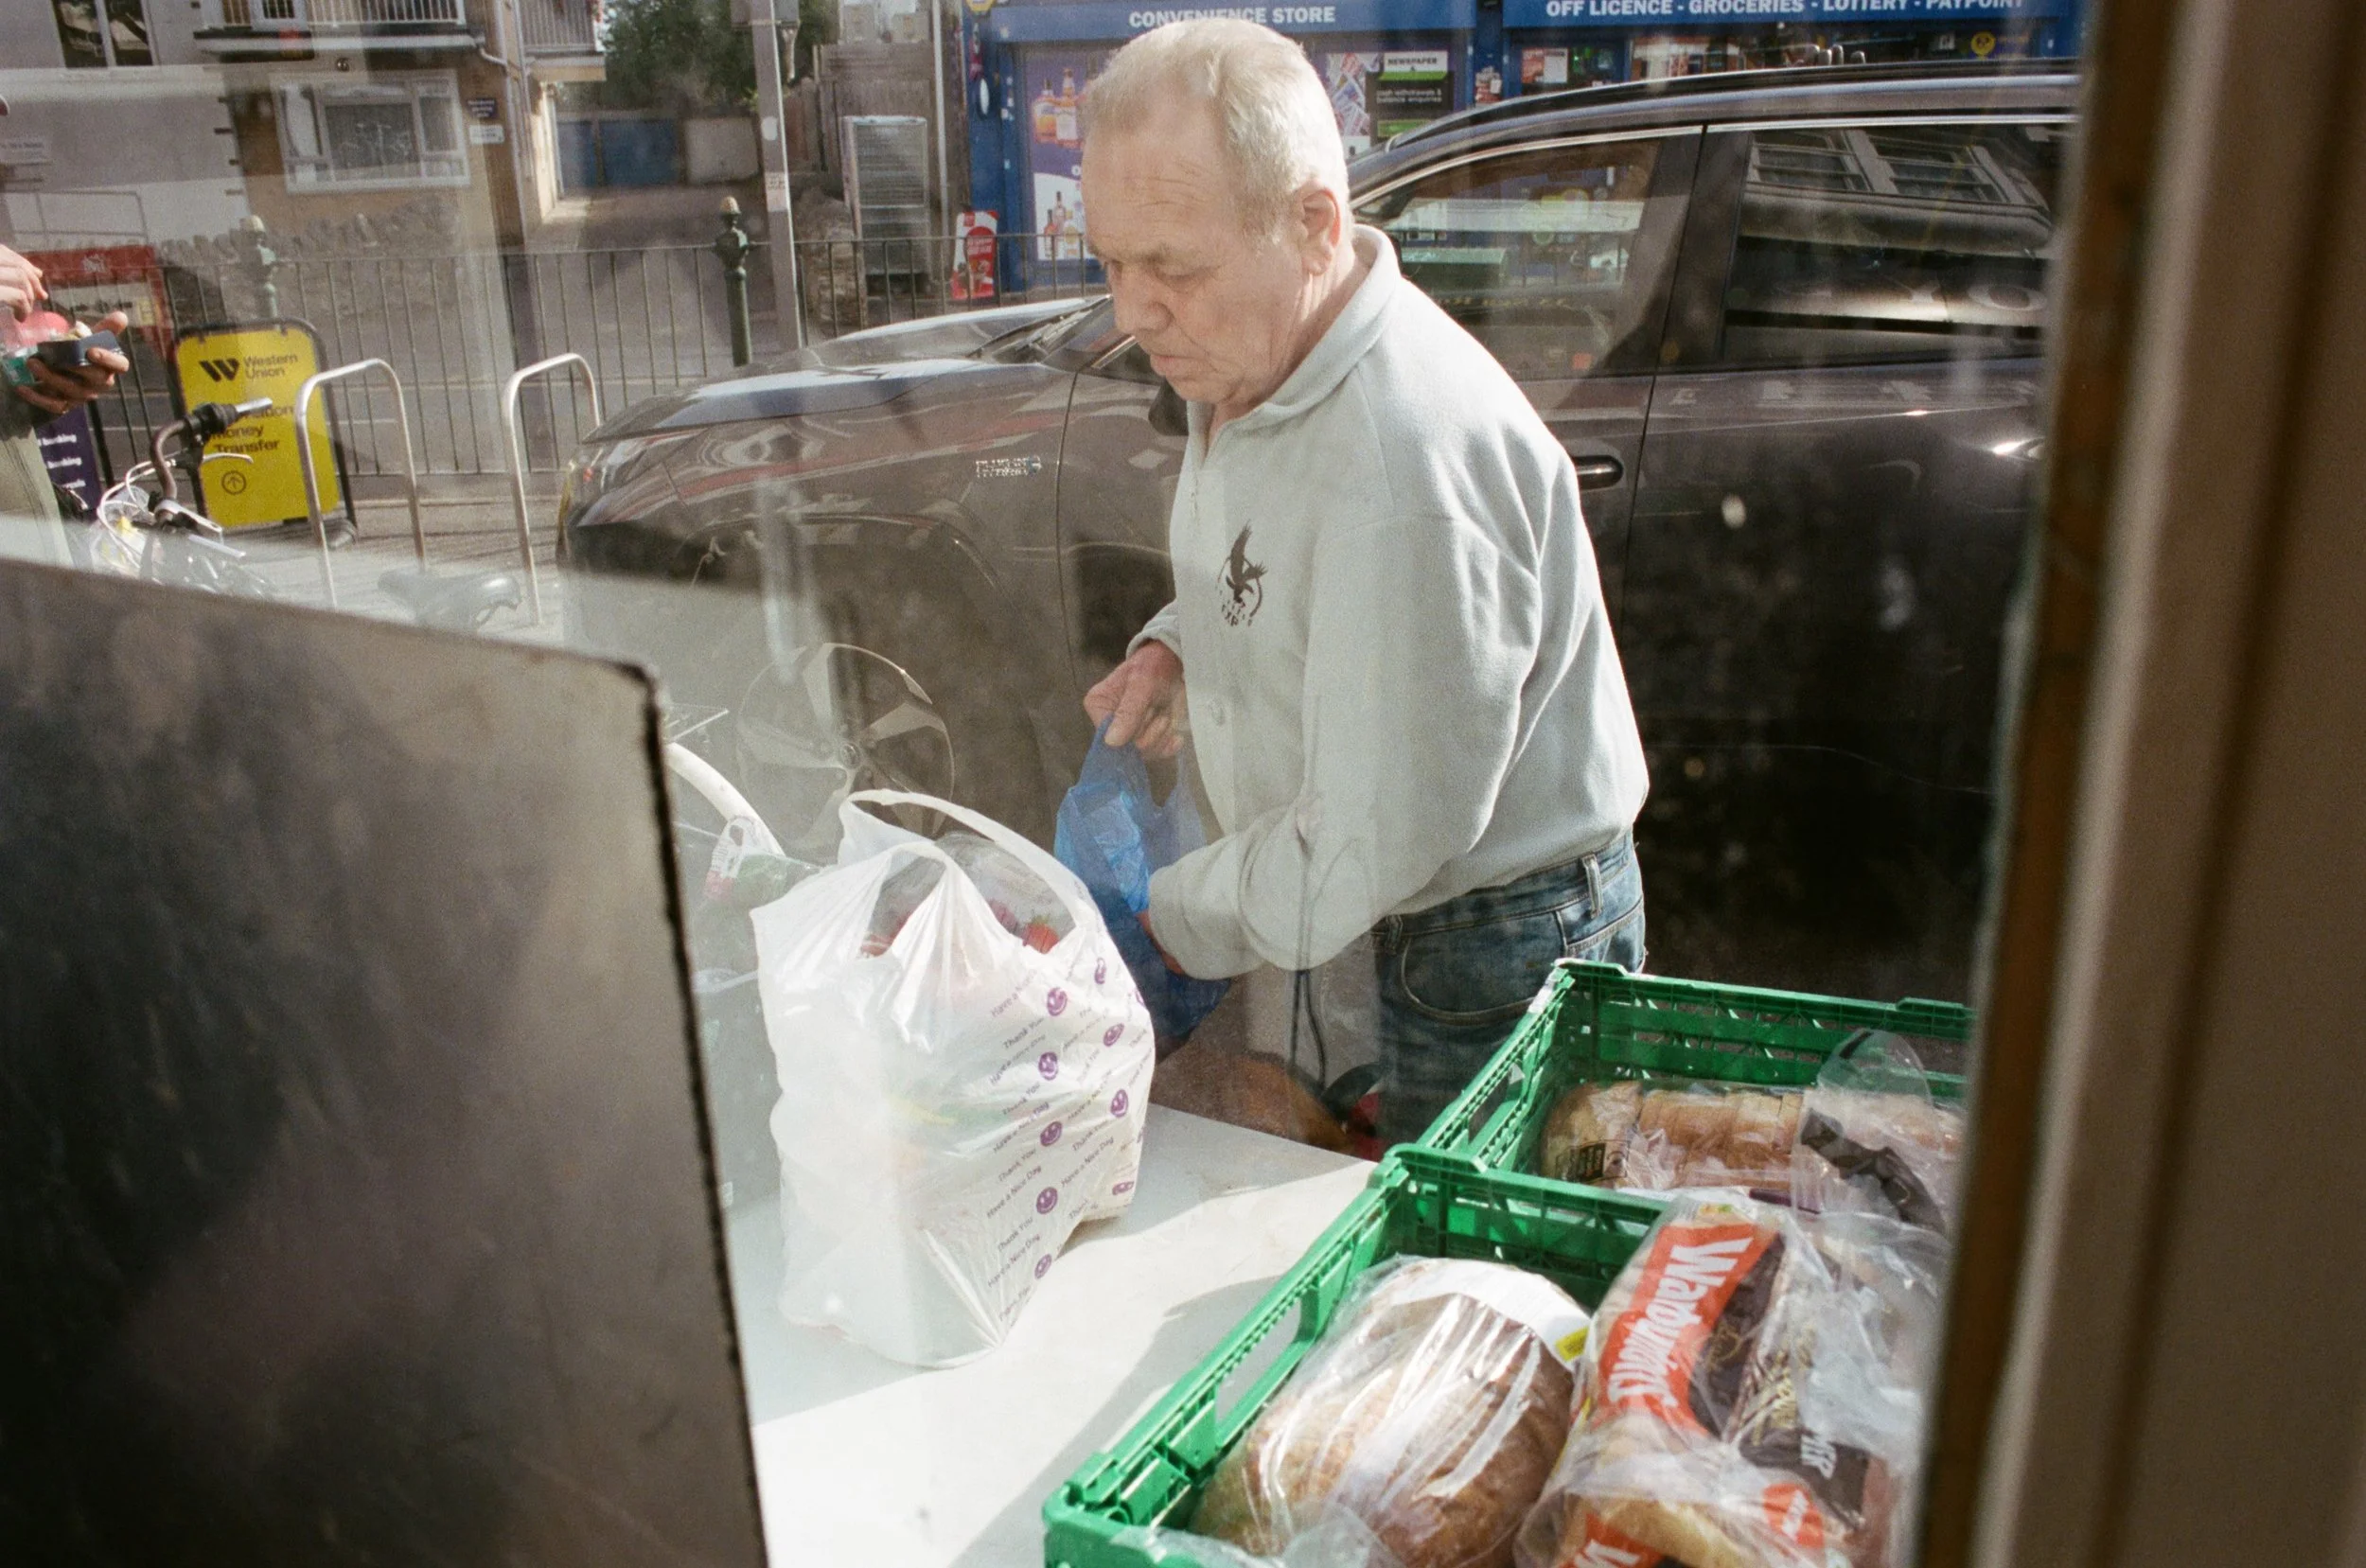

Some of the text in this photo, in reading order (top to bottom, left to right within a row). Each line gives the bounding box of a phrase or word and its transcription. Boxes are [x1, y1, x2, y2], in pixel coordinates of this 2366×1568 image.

[1272, 6, 1336, 24] STORE
[1545, 0, 1584, 16] OFF
[1589, 0, 1673, 16] LICENCE
[1688, 0, 1804, 14] GROCERIES
[1387, 57, 1438, 65] NEWSPAPER
[243, 353, 298, 367] Western
[244, 365, 286, 379] Union
[211, 438, 281, 453] Transfer
